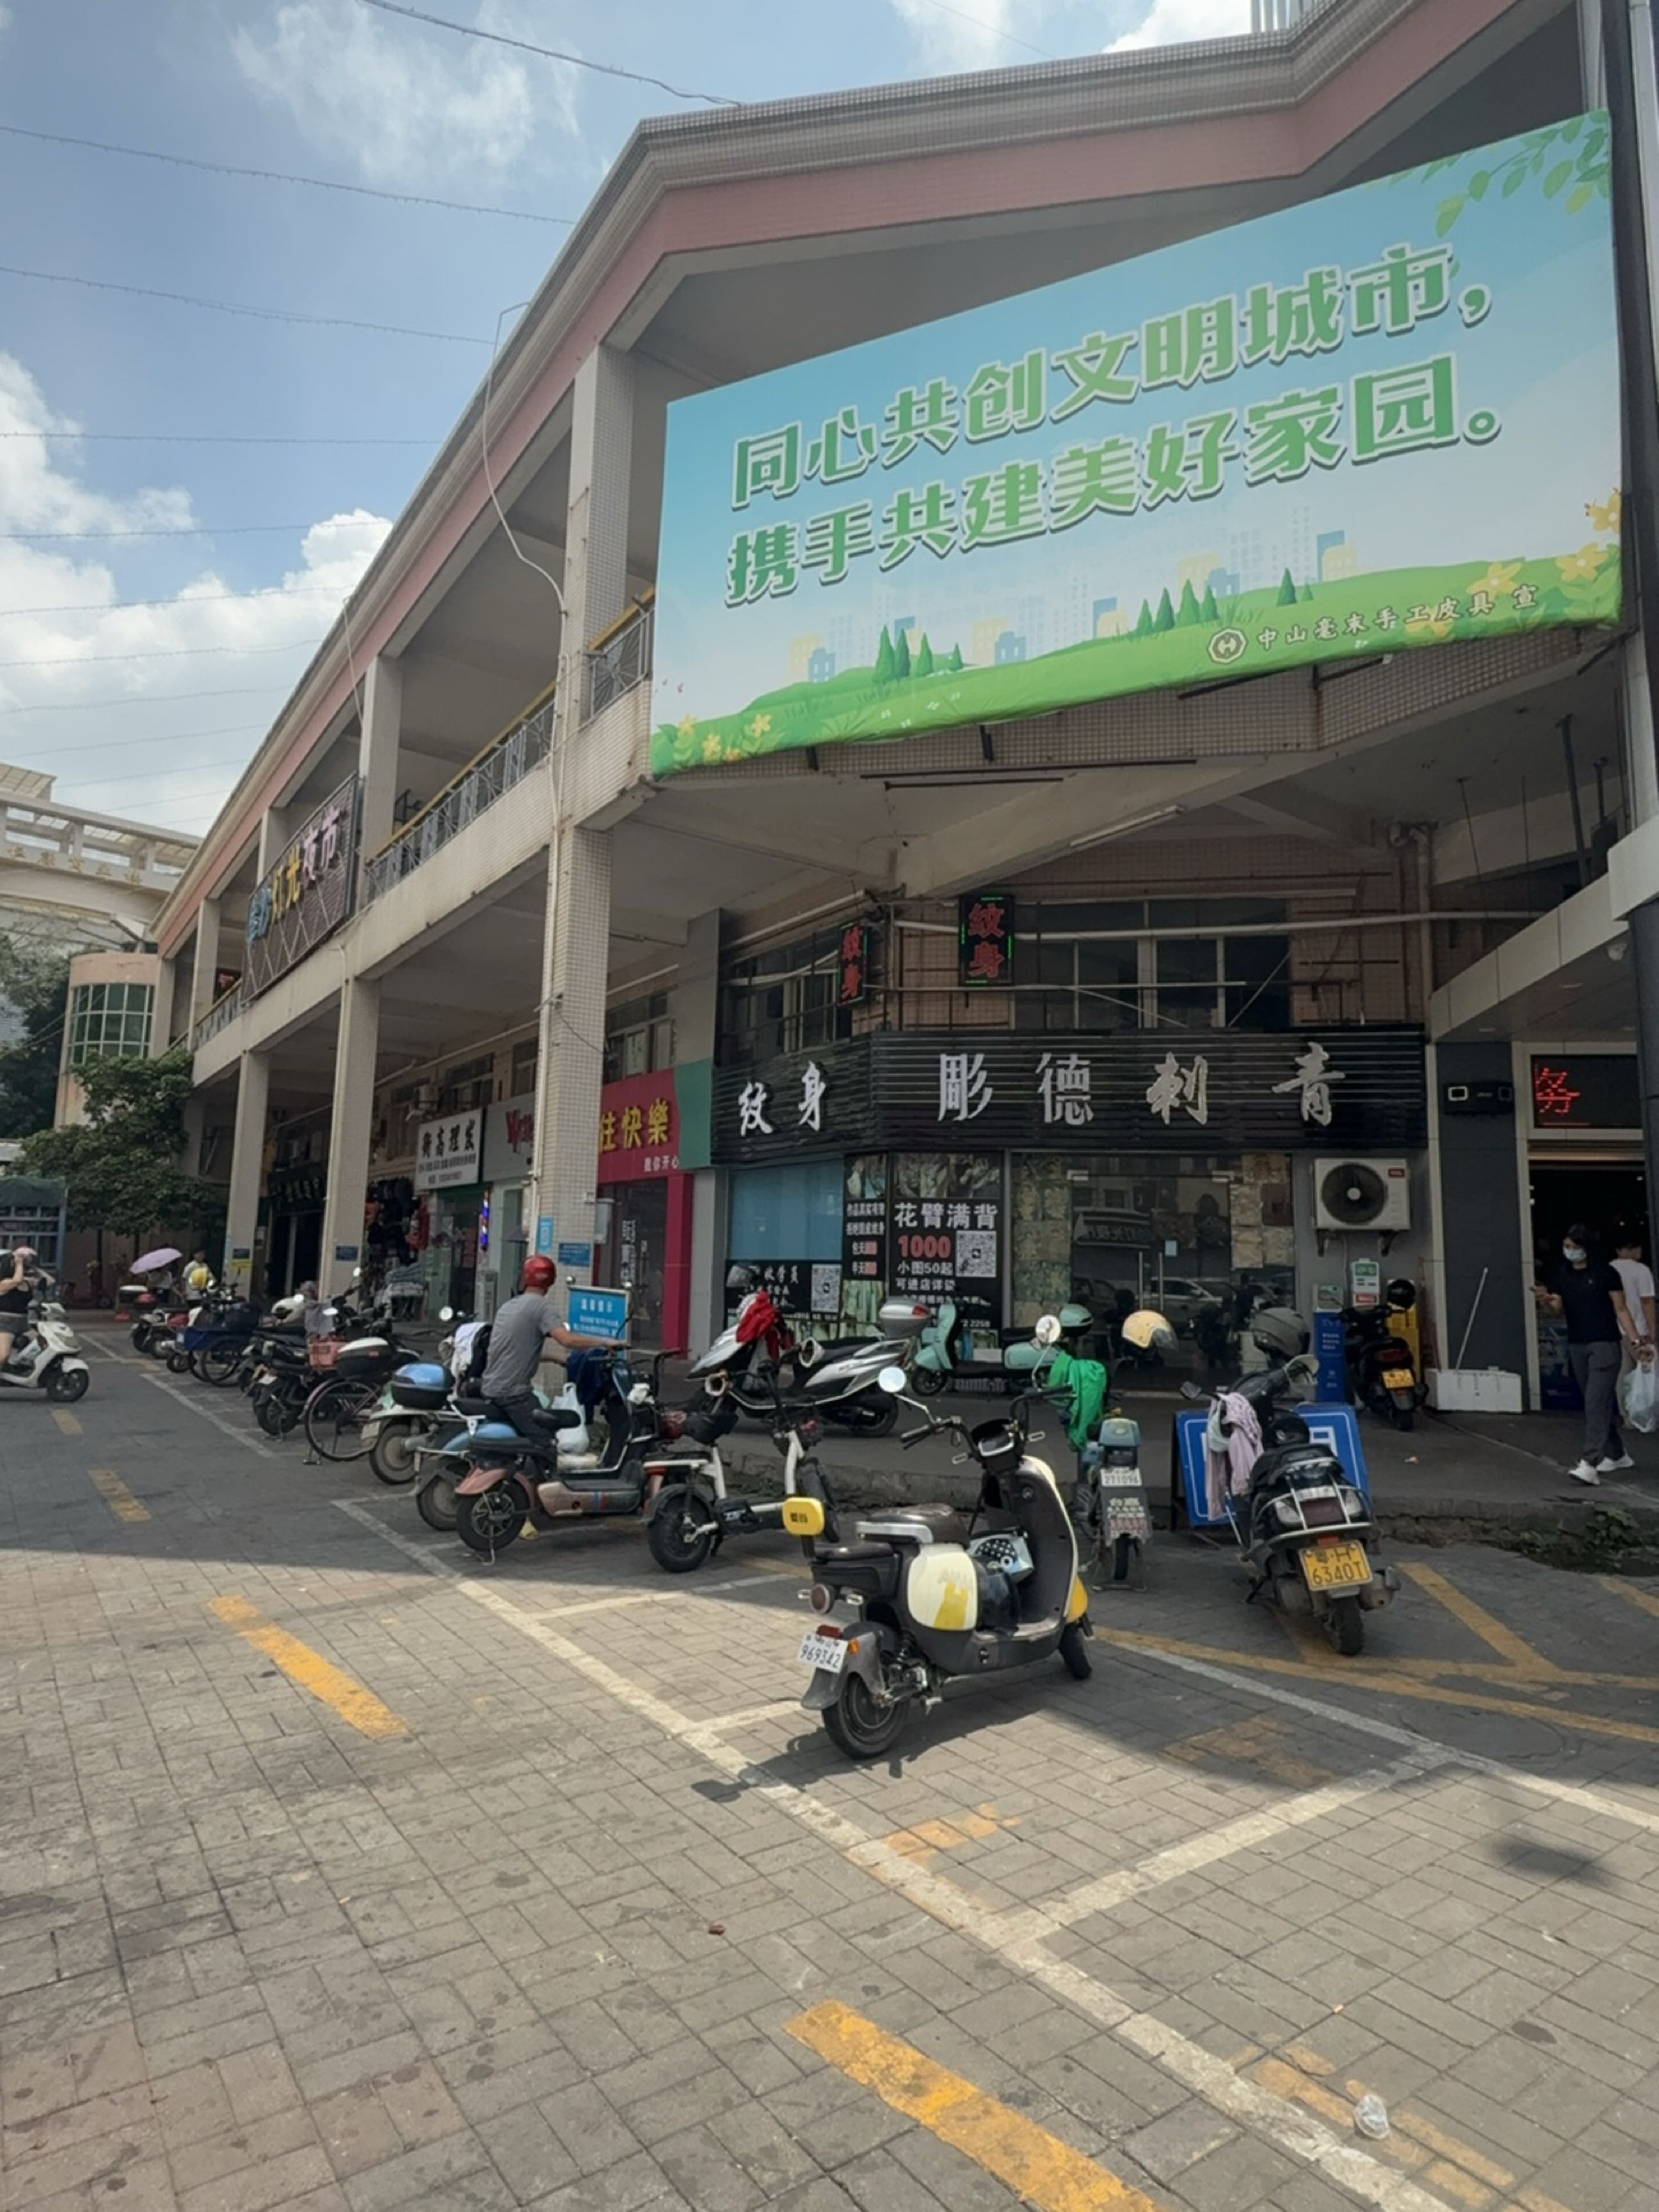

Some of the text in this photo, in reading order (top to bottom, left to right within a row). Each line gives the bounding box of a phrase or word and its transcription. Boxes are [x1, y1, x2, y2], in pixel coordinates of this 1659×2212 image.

[732, 242, 1492, 510] 同心共创文明城市，
[726, 355, 1502, 605] 携手共建美好家园。
[1511, 583, 1538, 609] 宣
[968, 902, 1006, 978] 纹身
[738, 1061, 826, 1136] 纹身
[894, 1202, 998, 1230] 花臂满背
[897, 1262, 953, 1276] 小图50起
[899, 1235, 951, 1258] 1000
